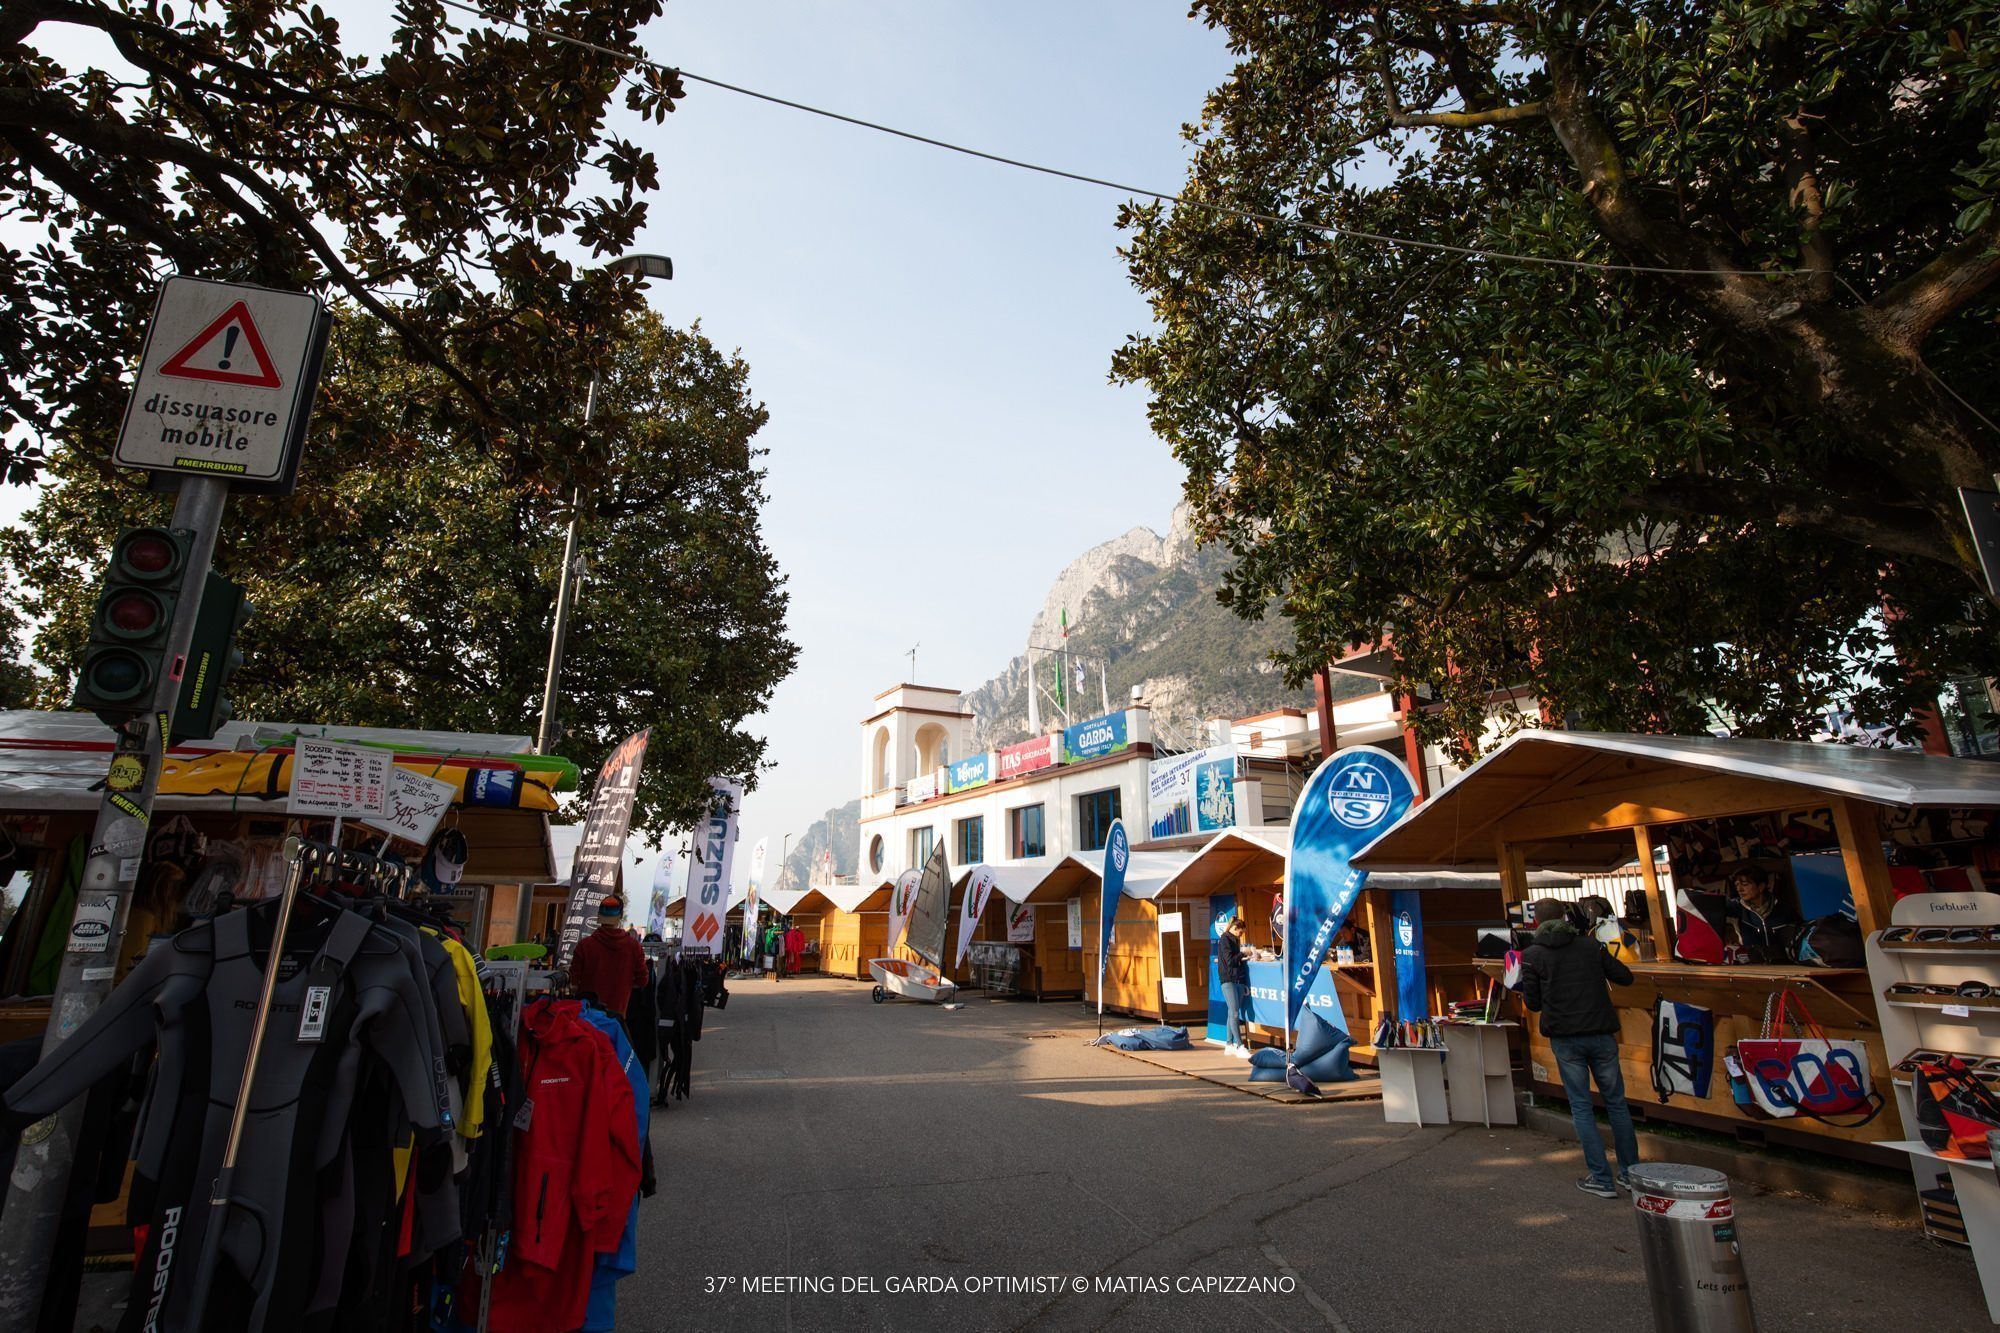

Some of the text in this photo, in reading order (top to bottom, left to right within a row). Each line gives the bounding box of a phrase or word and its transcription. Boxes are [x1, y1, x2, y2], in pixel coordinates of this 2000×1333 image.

[144, 393, 278, 426] dissuasore
[161, 426, 249, 451] mobile
[176, 458, 245, 473] #MEHRBUMS
[190, 651, 211, 710] #MEHRBUMS
[1078, 726, 1115, 749] GARDA
[1002, 751, 1021, 771] ITAS
[395, 773, 434, 791] SANDILINE
[1179, 769, 1191, 786] 37
[1346, 771, 1376, 789] N
[418, 790, 441, 802] SUITS
[1343, 801, 1371, 819] S
[1294, 869, 1361, 992] NORTH SAIL
[1243, 985, 1334, 1008] ORTH SLS
[234, 1000, 300, 1013] ROSTE
[310, 1006, 321, 1018] JS
[540, 1077, 570, 1085] ROOSTER
[1754, 1048, 1866, 1108] 603
